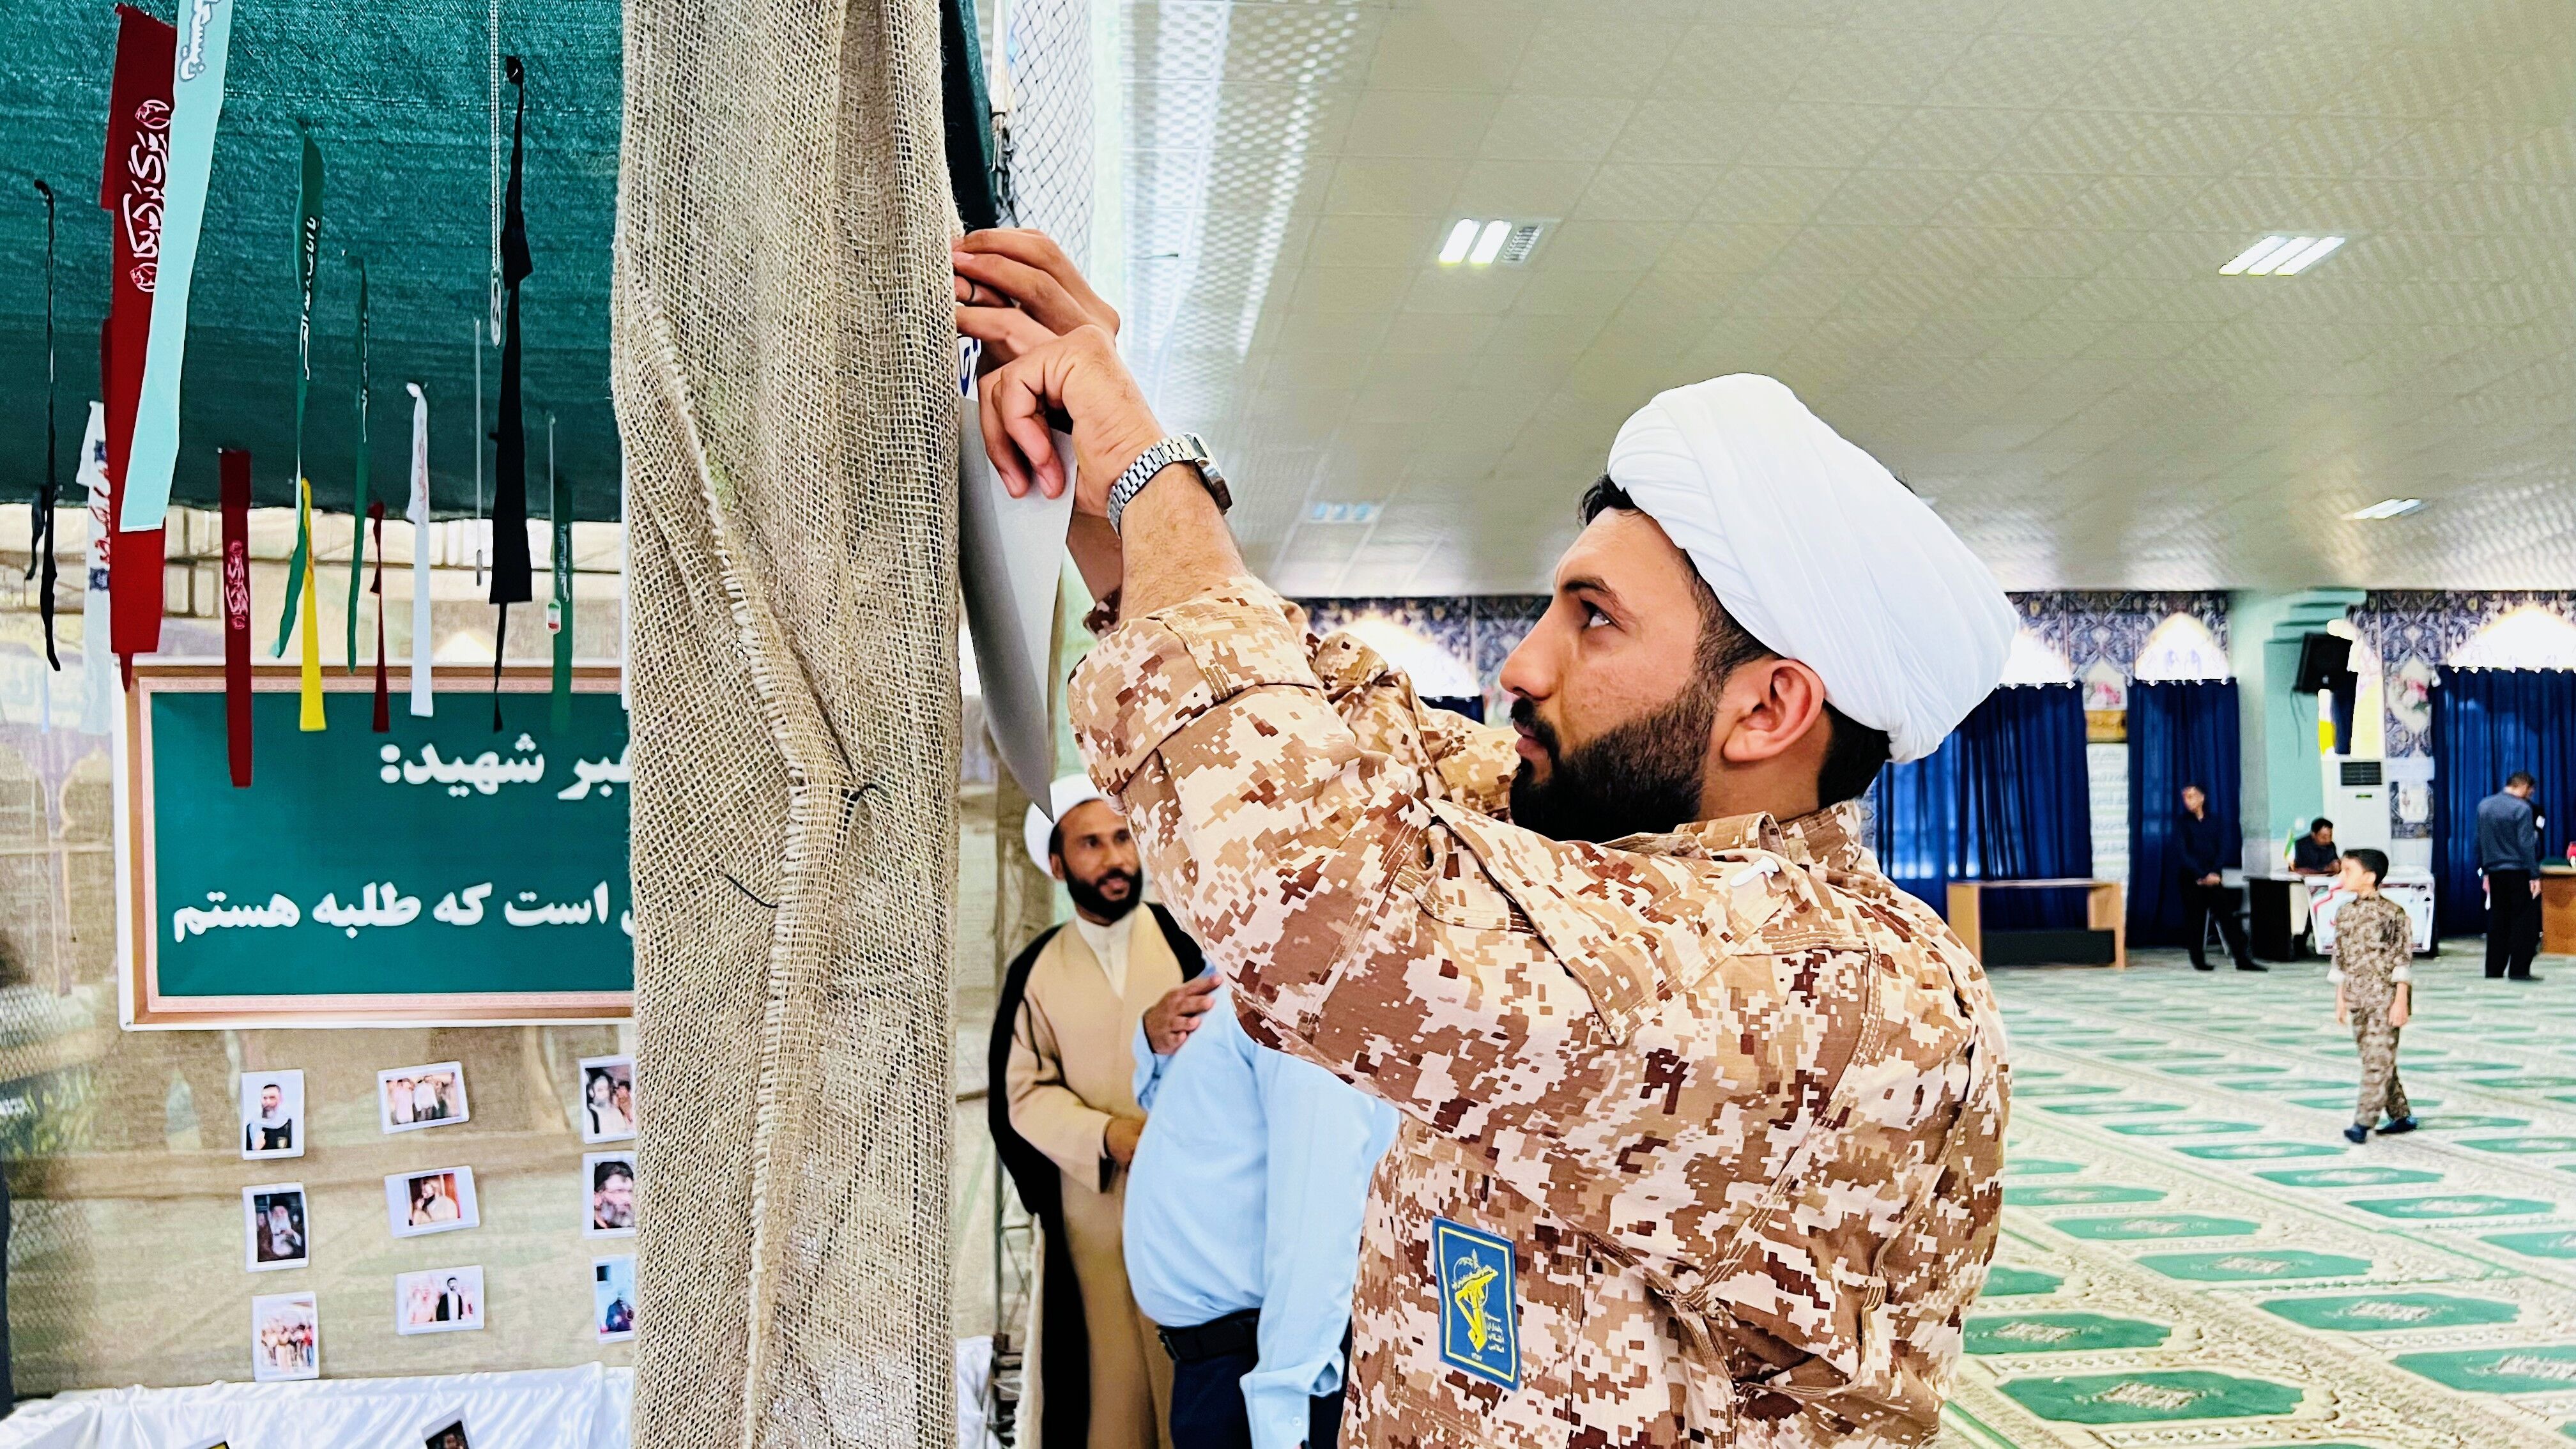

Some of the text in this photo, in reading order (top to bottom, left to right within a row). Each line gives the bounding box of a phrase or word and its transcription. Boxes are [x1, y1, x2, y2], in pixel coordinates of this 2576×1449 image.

[380, 732, 545, 795] شهید:
[174, 891, 301, 943] هستم
[312, 880, 422, 940] طلبه
[433, 882, 493, 926] که
[503, 880, 609, 927] است
